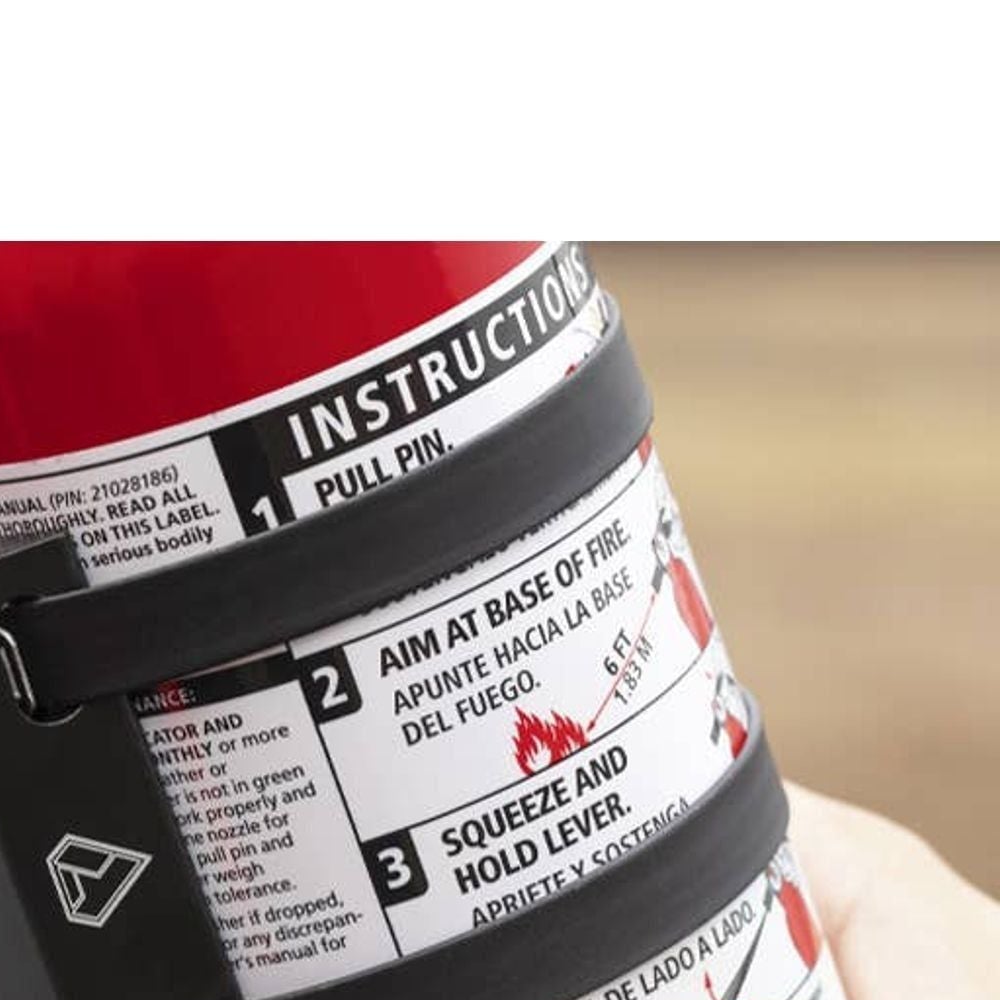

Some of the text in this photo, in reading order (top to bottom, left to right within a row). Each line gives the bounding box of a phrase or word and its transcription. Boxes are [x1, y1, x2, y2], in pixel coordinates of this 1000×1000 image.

[287, 243, 588, 460] INSTRUCTIONS
[91, 464, 179, 502] 21028186)
[315, 427, 454, 508] PULL PIN.
[106, 495, 158, 521] READ
[162, 483, 198, 507] ALL
[252, 496, 280, 531] 1
[81, 502, 221, 548] ON THIS LABEL.
[91, 544, 153, 567] serious
[155, 526, 214, 553] bodily
[379, 627, 441, 679] AIM
[447, 609, 481, 653] AT
[488, 572, 554, 631] BASE
[555, 548, 587, 588] OF
[589, 517, 632, 568] FIRE.
[393, 566, 634, 715] APUNTE HACIA LA BASE
[604, 628, 633, 677] 6 FT
[312, 665, 349, 710] 2
[613, 634, 655, 708] 1.83 M
[203, 713, 244, 736] AND
[402, 670, 542, 748] DEL FUEGO.
[218, 740, 237, 754] or
[242, 724, 291, 749] more
[184, 789, 198, 804] is
[200, 783, 230, 801] not
[231, 779, 250, 795] in
[252, 764, 306, 793] green
[209, 763, 228, 778] or
[177, 808, 204, 827] ork
[206, 793, 278, 825] properly
[281, 780, 318, 805] and
[441, 744, 629, 858] SQUEEZE AND
[206, 820, 262, 844] nozzle
[264, 812, 290, 832] for
[454, 792, 633, 895] HOLD LEVER.
[197, 832, 295, 867] pull pin and
[377, 847, 412, 891] 3
[213, 860, 266, 886] weigh
[213, 879, 298, 905] tolerance.
[249, 908, 263, 926] if
[264, 891, 345, 925] dropped,
[242, 931, 273, 950] any
[274, 910, 364, 944] discrepan-
[643, 944, 696, 994] LADO
[697, 936, 715, 960] A
[712, 897, 759, 949] LADO.
[256, 939, 320, 968] manual
[321, 934, 347, 955] for
